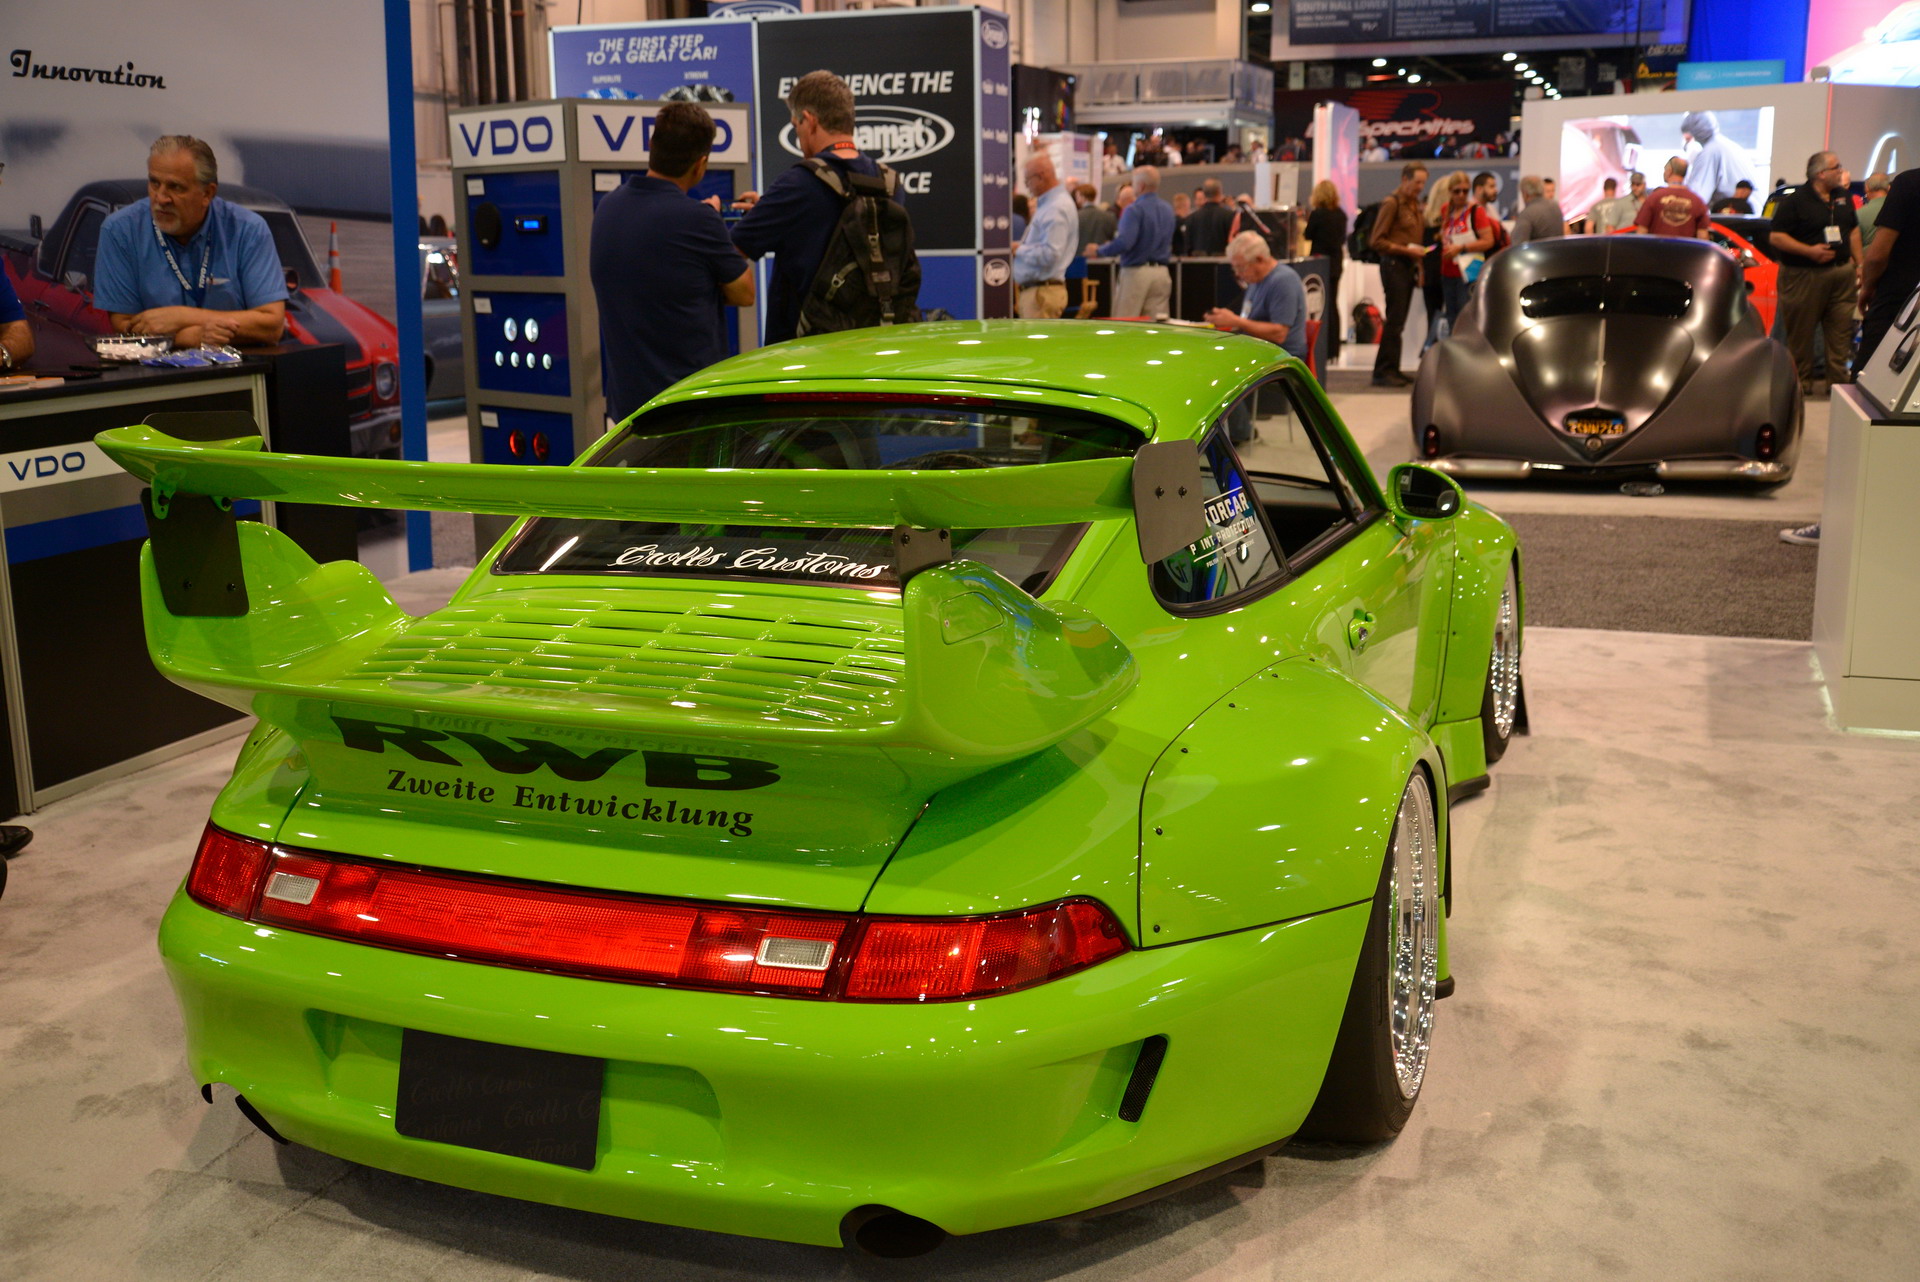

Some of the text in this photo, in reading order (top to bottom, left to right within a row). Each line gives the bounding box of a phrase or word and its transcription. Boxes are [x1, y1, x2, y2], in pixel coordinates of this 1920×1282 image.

[586, 46, 718, 65] TO A GREAT CAR!
[599, 33, 704, 52] THE FIRST STEP
[10, 49, 166, 89] Innovation
[909, 70, 954, 94] THE
[459, 115, 554, 157] VDO
[8, 451, 85, 481] VDO
[1215, 516, 1256, 543] PROTECTION
[725, 547, 890, 579] Customs
[331, 715, 781, 791] RWB
[386, 769, 754, 837] Zweite Entwicklung
